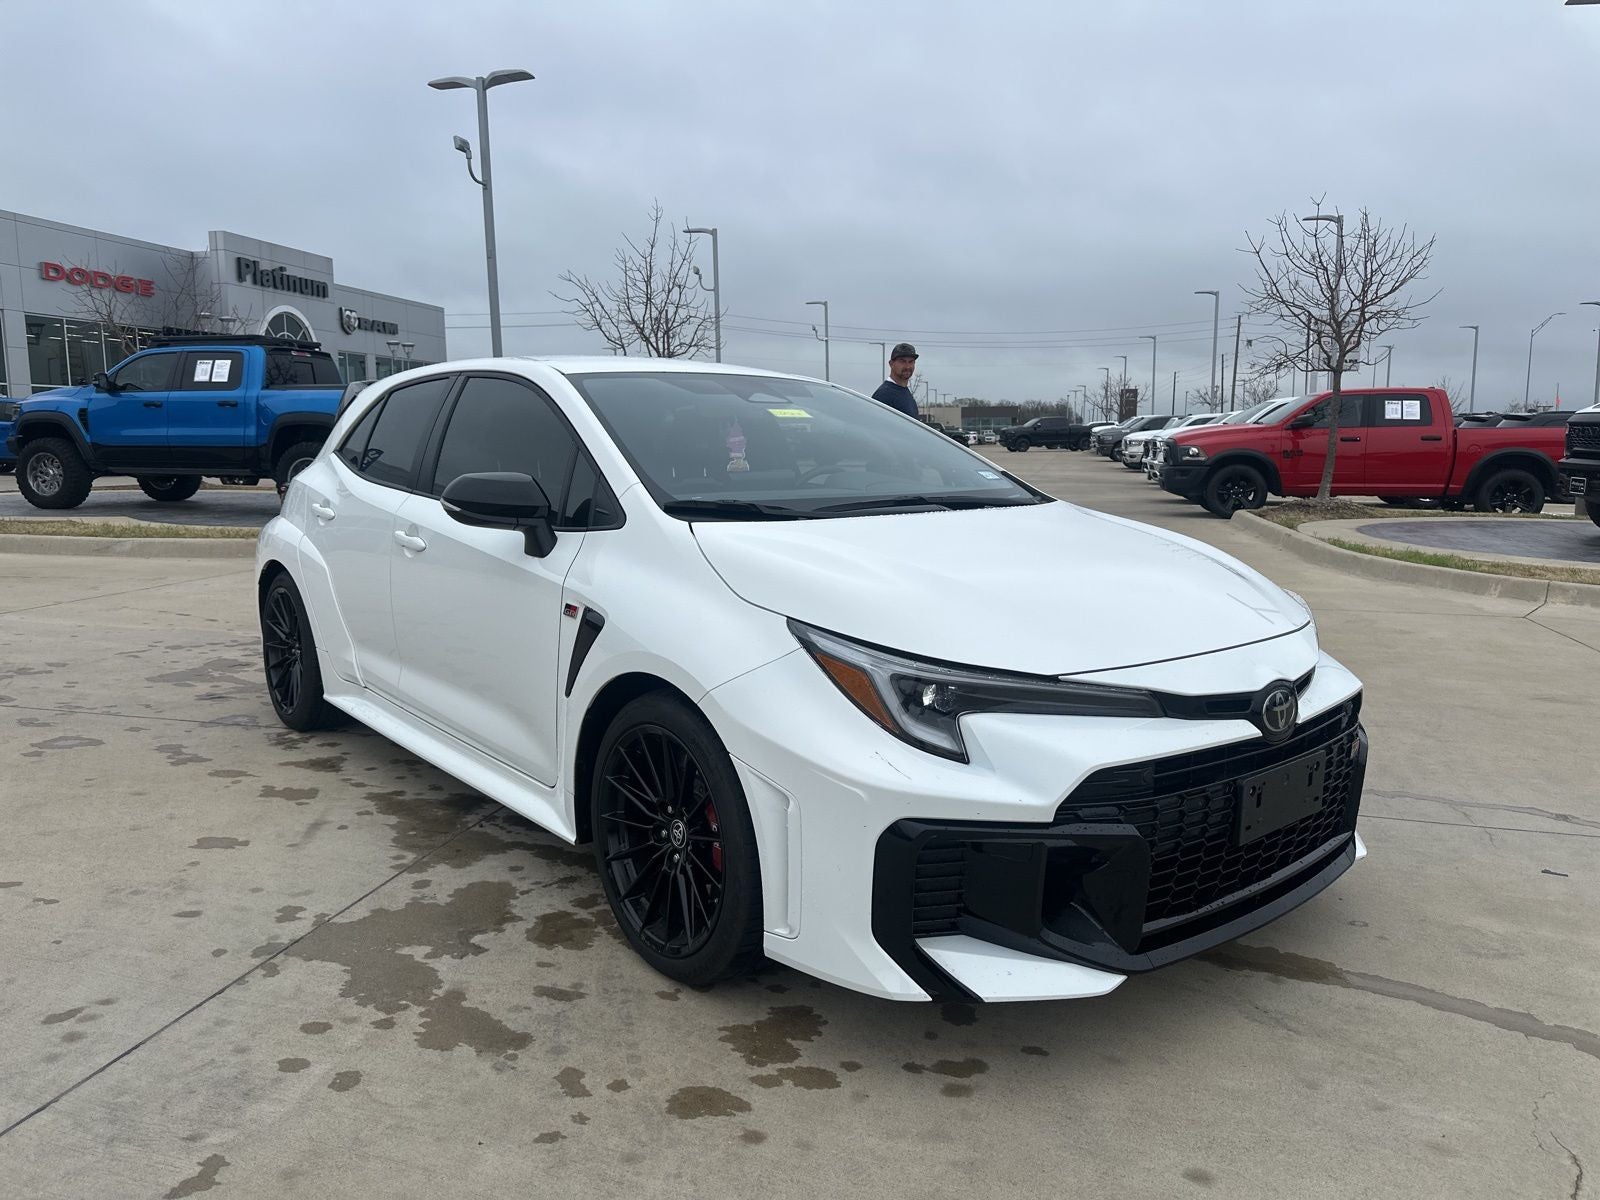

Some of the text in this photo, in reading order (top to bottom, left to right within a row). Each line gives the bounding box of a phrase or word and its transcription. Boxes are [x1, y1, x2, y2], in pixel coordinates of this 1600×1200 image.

[40, 261, 155, 297] DODGE
[237, 257, 328, 298] Platinum
[358, 317, 399, 335] RAM
